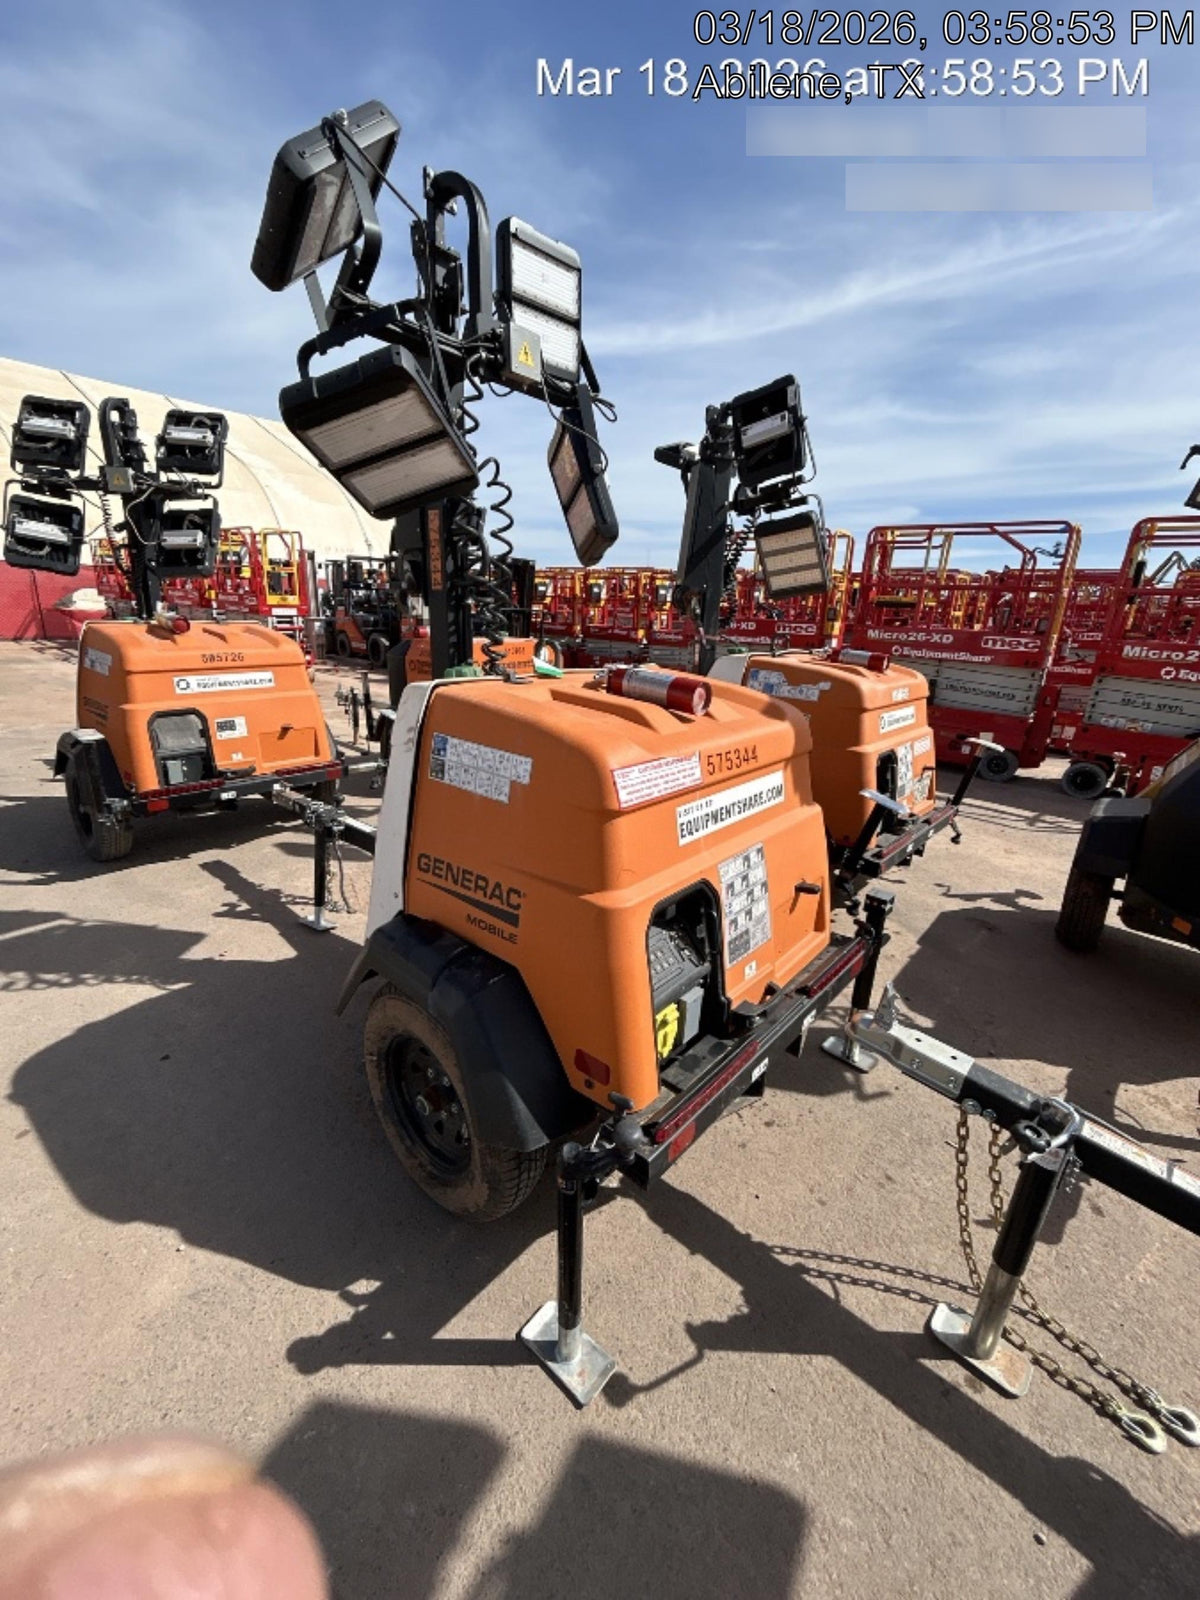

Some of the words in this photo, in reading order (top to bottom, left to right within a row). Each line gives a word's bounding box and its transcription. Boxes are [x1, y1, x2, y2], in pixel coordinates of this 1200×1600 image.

[867, 629, 954, 645] Micro26-XD
[902, 645, 992, 663] EquipmentShare
[706, 745, 758, 776] 575344
[679, 783, 784, 840] EQUIPMENTSHARE.COM
[417, 853, 522, 911] GENERAC
[466, 913, 519, 945] MOBILE
